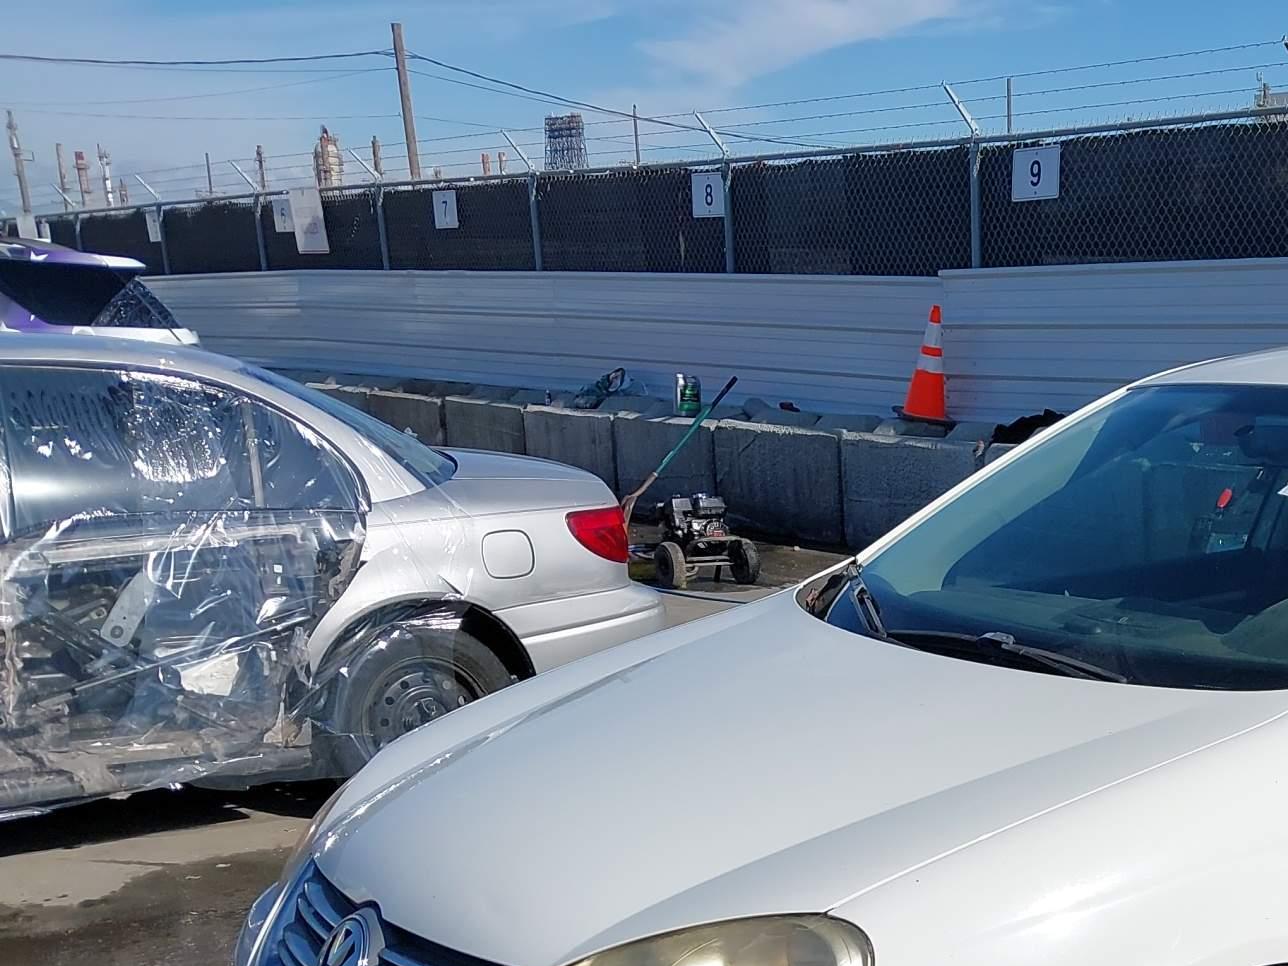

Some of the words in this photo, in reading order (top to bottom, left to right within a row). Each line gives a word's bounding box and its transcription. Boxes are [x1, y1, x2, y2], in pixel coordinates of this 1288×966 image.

[1030, 160, 1042, 187] 9
[705, 183, 714, 207] 8
[441, 200, 448, 218] 7
